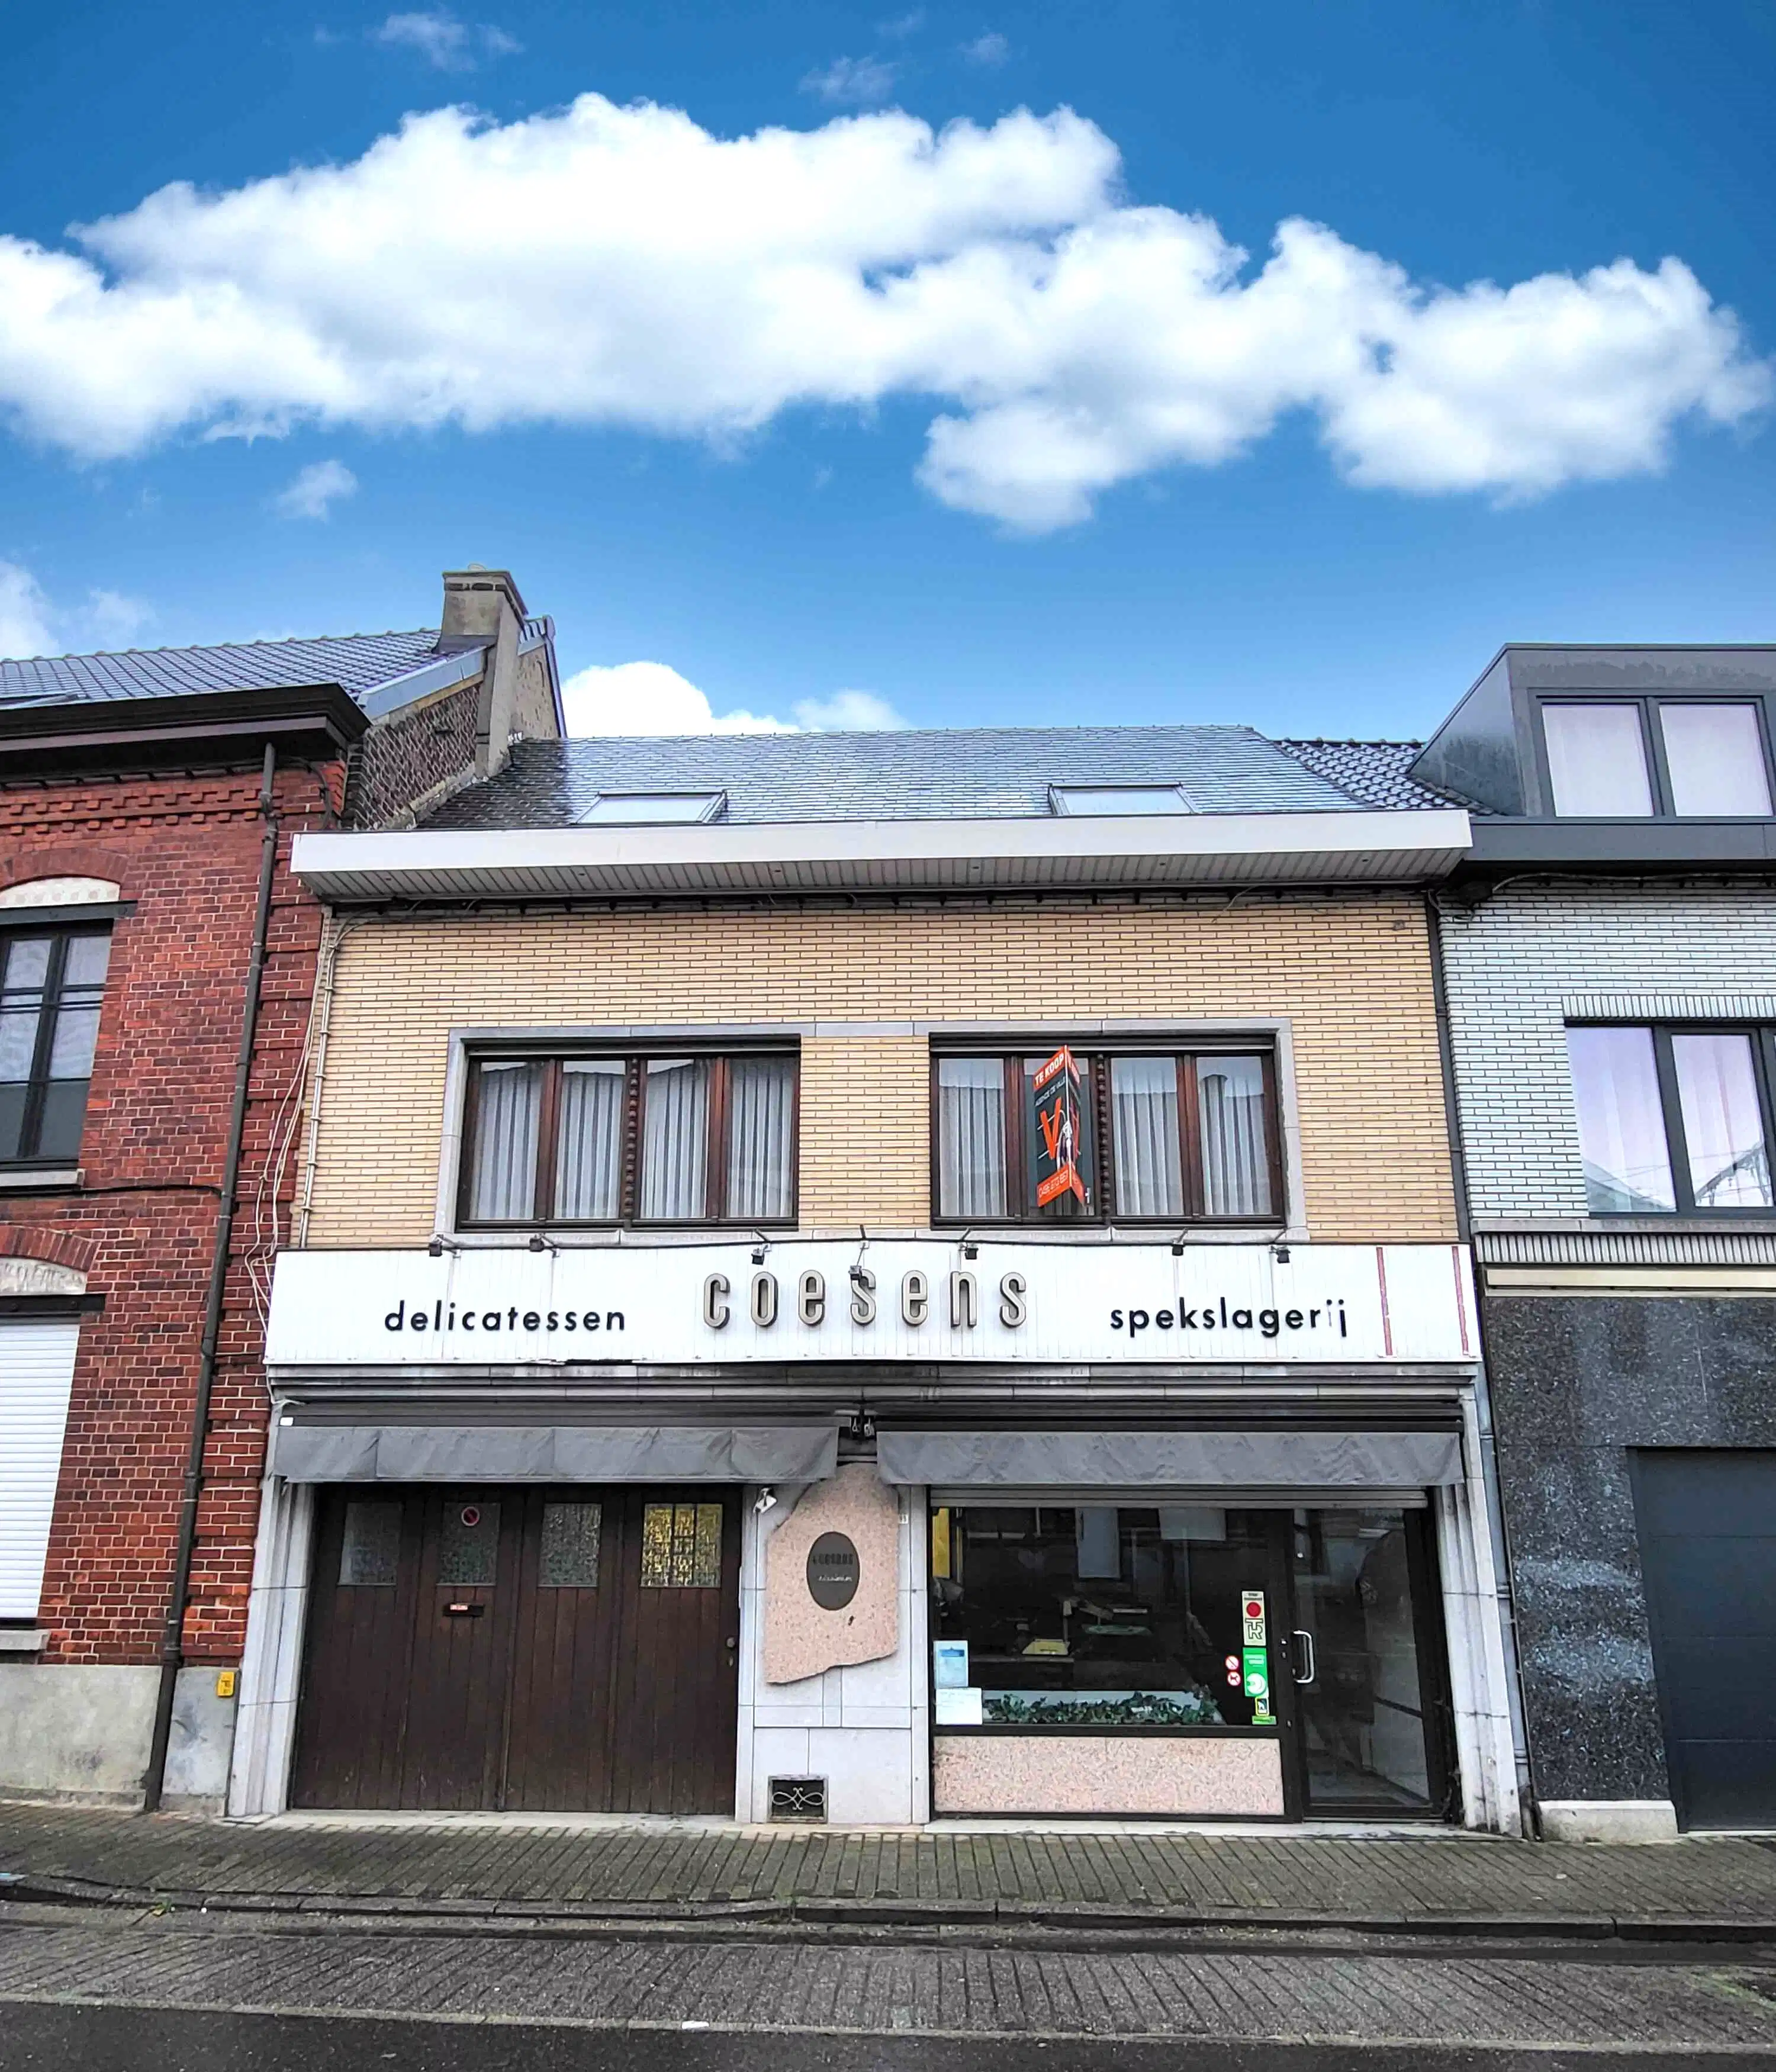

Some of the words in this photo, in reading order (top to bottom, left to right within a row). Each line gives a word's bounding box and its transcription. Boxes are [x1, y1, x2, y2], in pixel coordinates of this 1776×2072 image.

[1035, 1070, 1044, 1087] TE
[1044, 1052, 1064, 1079] KOOP
[384, 1299, 625, 1332] delicatessen
[703, 1269, 1027, 1329] coesens
[1109, 1296, 1347, 1338] spekslagerij
